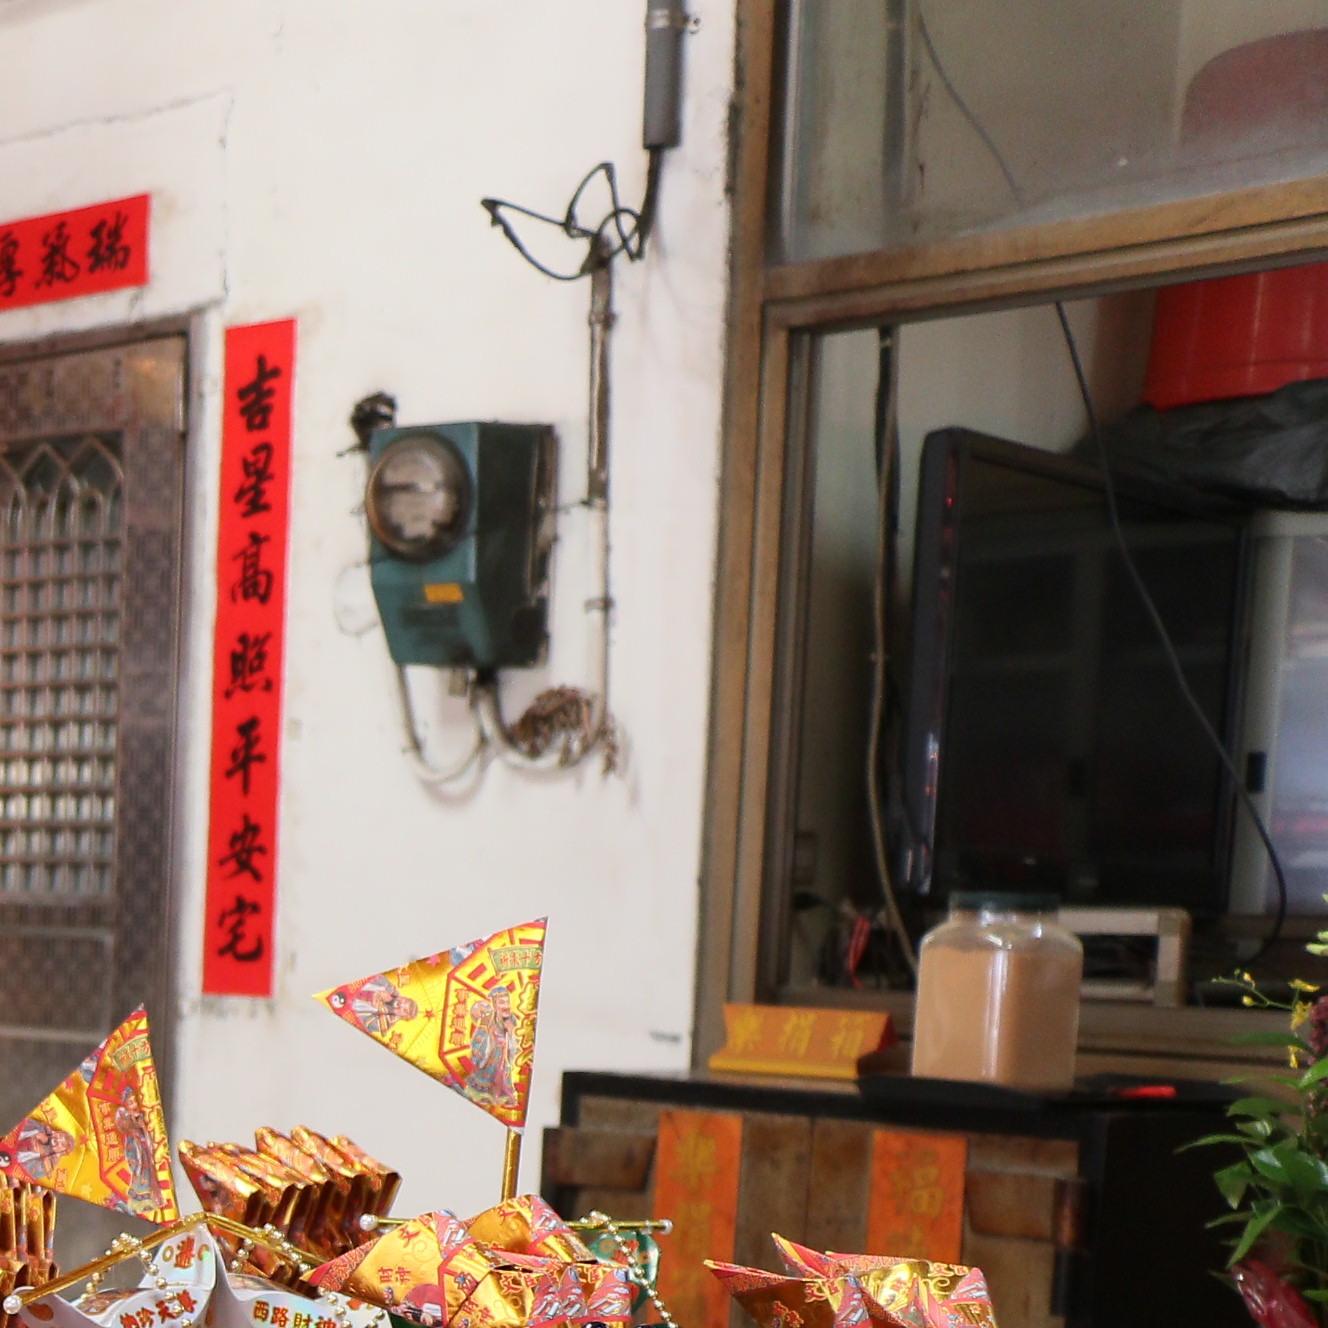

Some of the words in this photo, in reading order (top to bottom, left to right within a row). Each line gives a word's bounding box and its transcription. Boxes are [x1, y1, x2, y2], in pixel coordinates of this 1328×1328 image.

[217, 354, 283, 963] 吉星高照平安宅
